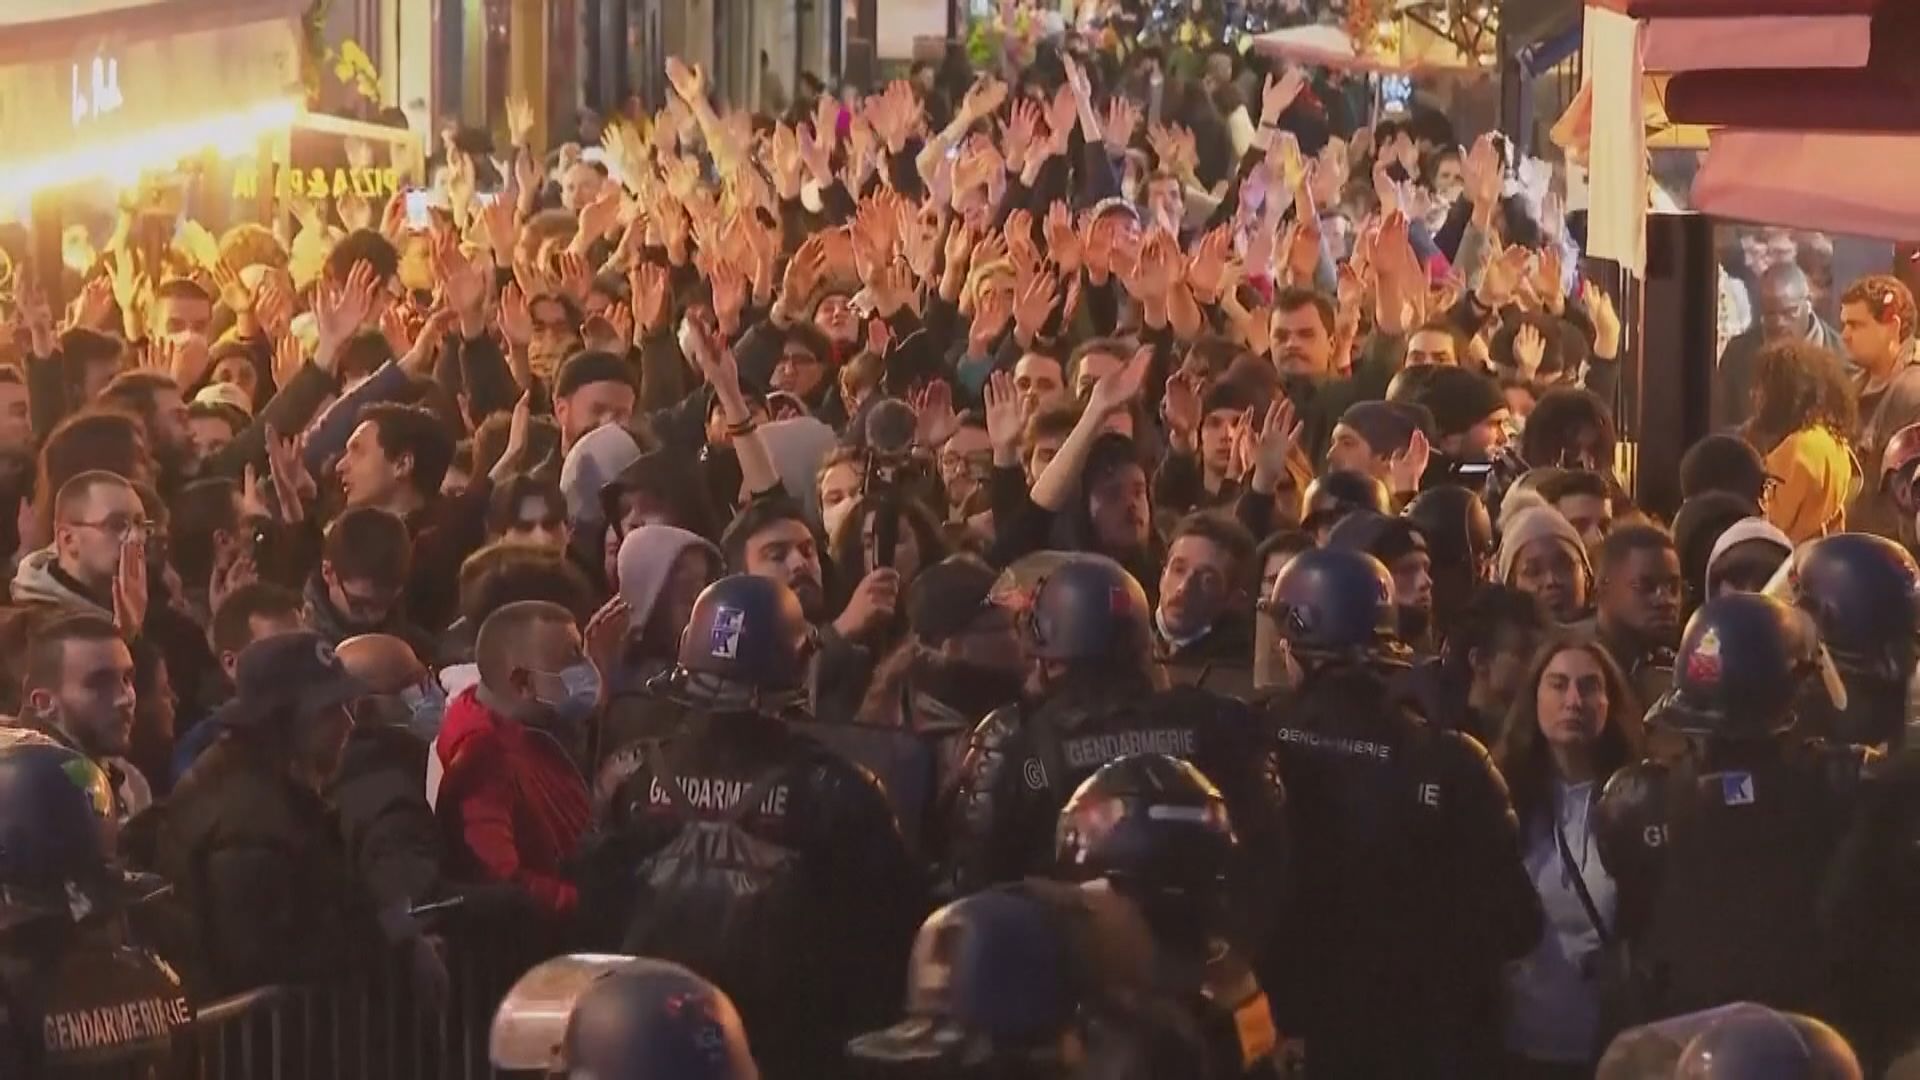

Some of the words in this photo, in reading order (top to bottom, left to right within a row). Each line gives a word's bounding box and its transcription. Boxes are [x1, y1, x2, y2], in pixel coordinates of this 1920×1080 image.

[1066, 730, 1194, 768] GENDARMERIE
[1277, 727, 1391, 759] GENDMERIE
[649, 775, 789, 816] GDARMIE
